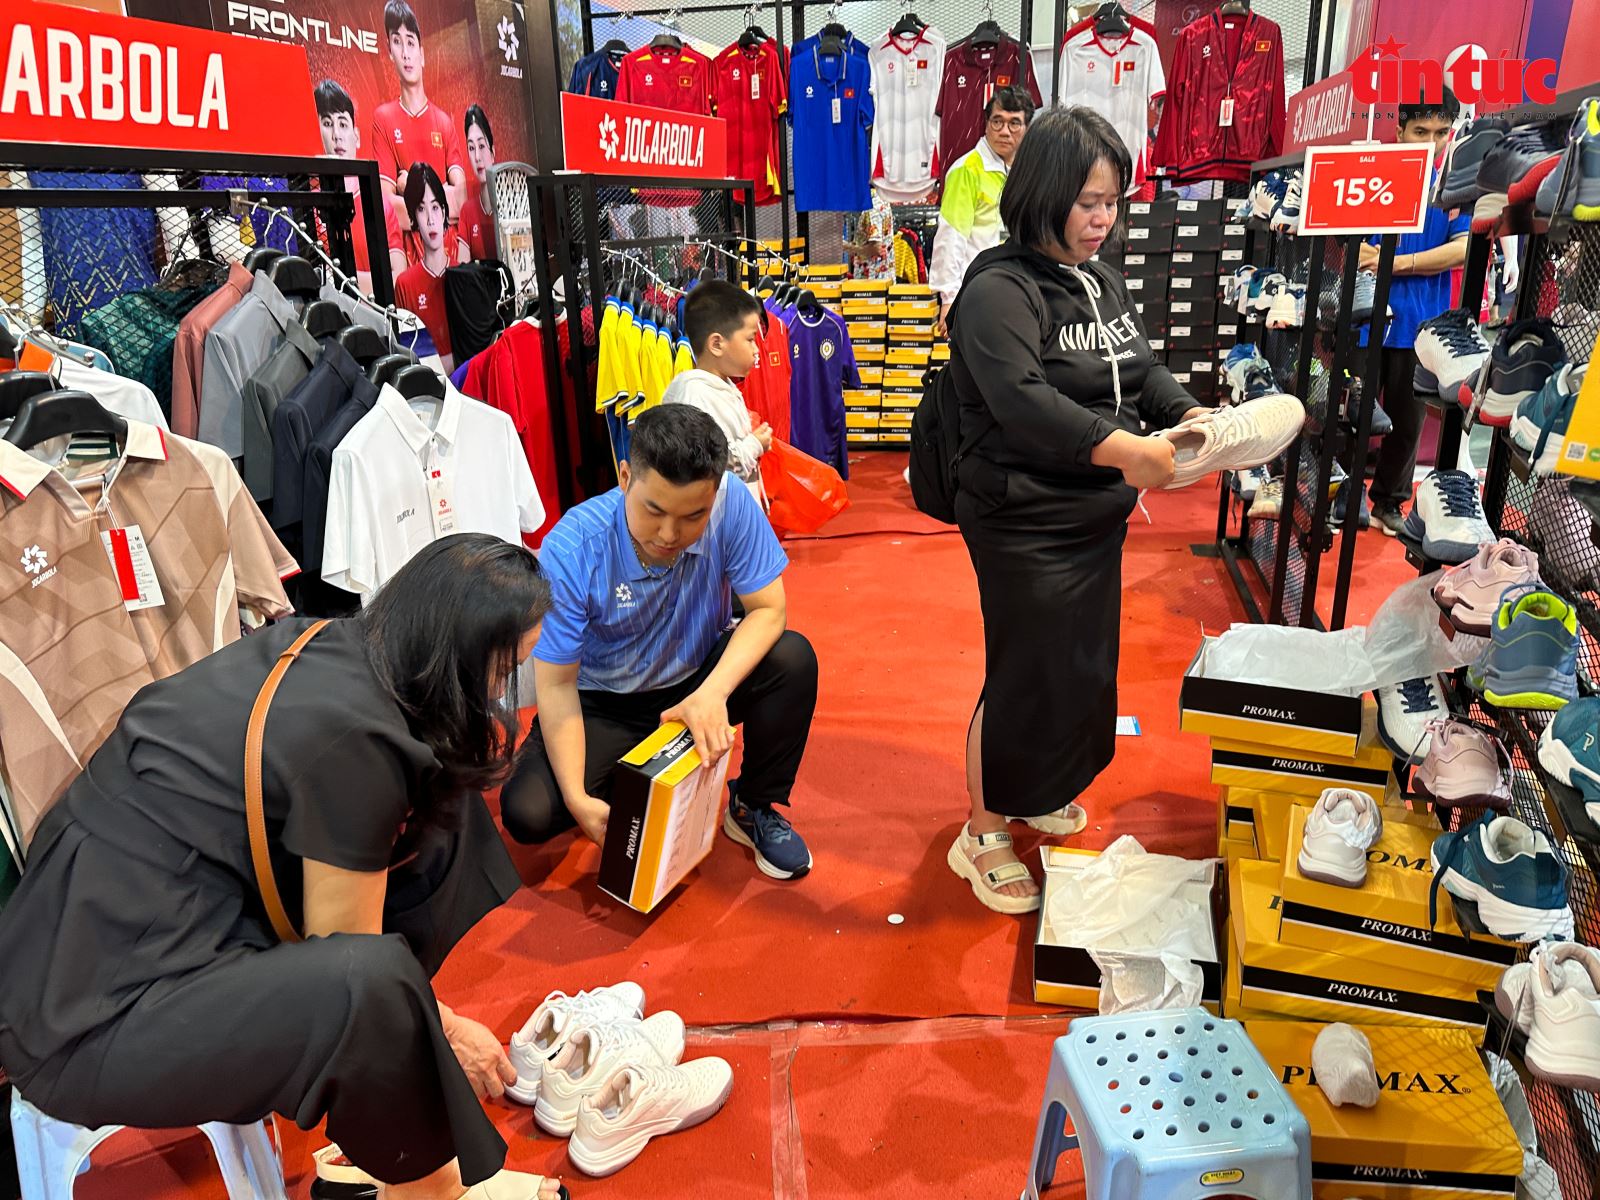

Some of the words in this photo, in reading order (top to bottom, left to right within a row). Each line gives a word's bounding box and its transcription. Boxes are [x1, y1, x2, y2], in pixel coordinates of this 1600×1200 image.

[228, 1, 379, 54] FRONTLINE
[620, 116, 704, 168] JOGARBOLA
[1333, 177, 1394, 206] 15%
[1241, 704, 1296, 720] PROMAX
[1271, 758, 1325, 773] PROMAX
[625, 816, 640, 860] PROMAX
[1360, 918, 1432, 942] PROMAX
[1327, 982, 1398, 1004] PROMAX
[1353, 1165, 1425, 1180] PROMAX
